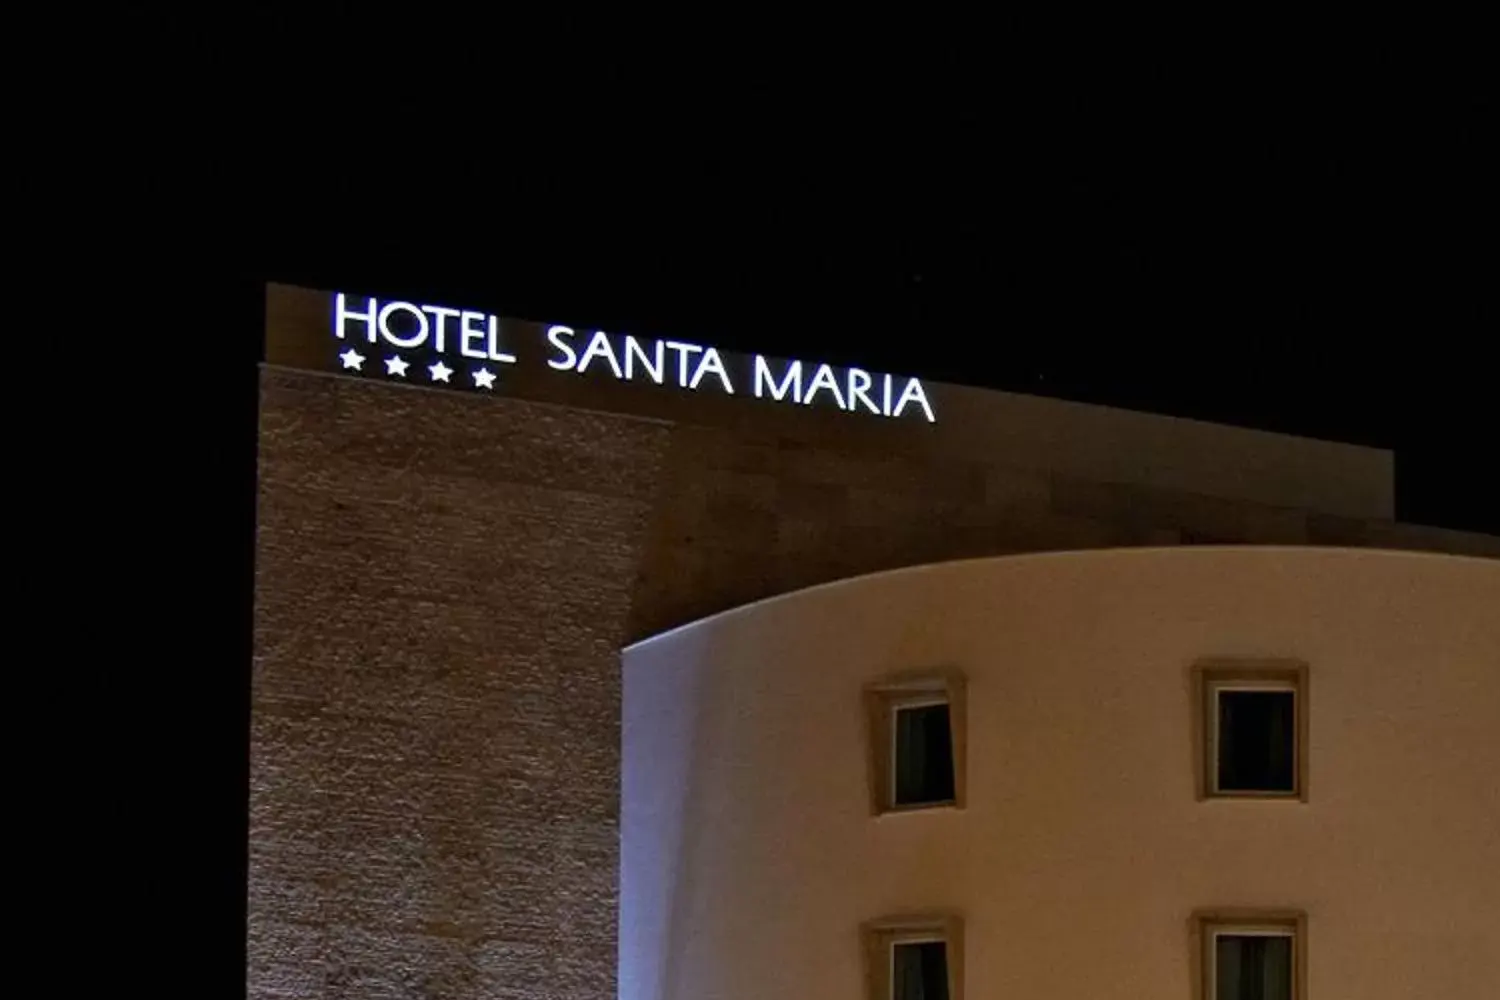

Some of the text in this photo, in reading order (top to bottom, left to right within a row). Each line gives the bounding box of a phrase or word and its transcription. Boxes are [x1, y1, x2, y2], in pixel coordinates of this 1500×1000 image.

[335, 293, 935, 423] HOTEL SANTA MARIA
